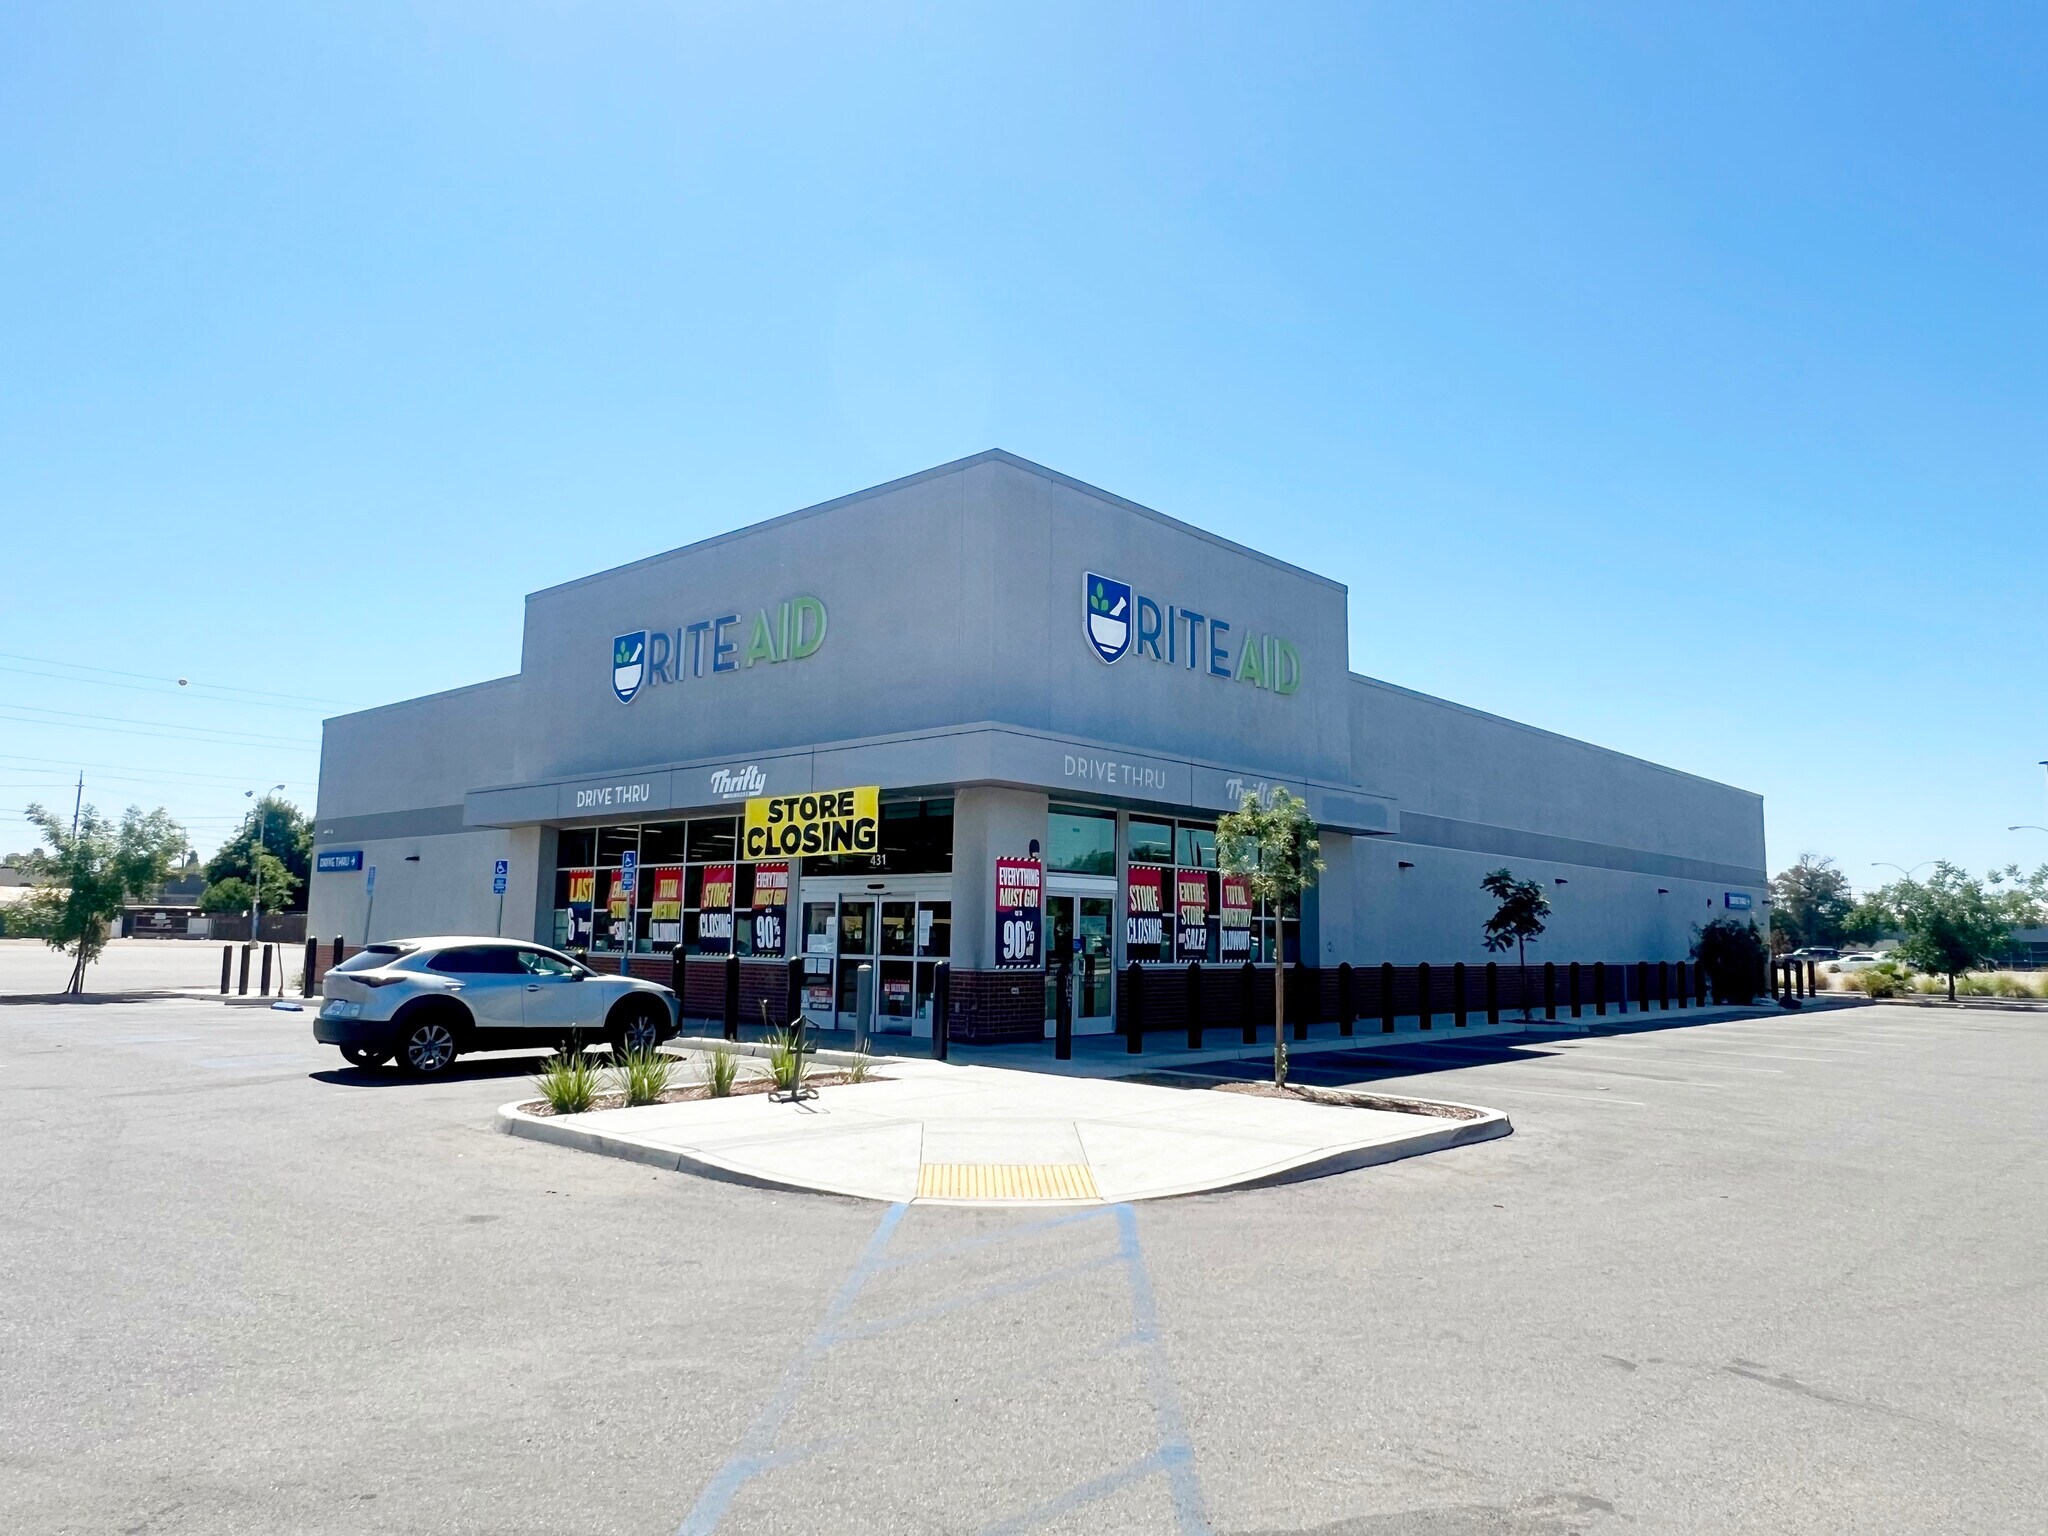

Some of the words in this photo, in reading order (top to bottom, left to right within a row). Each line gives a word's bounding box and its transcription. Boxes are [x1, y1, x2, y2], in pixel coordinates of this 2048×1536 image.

[649, 614, 741, 686] RITE
[745, 596, 828, 668] AID
[1132, 595, 1232, 679] RITE
[1234, 629, 1301, 695] AID
[711, 765, 766, 798] Thrifty
[1064, 755, 1117, 783] DRIVE
[1121, 764, 1165, 790] THRU
[577, 787, 612, 808] DRIVE
[615, 784, 650, 804] THRU
[768, 791, 854, 824] STORE
[747, 818, 877, 857] CLOSING
[870, 854, 886, 866] 431
[999, 867, 1040, 887] EVERYTHING
[569, 878, 594, 903] LAST
[704, 882, 732, 907] STORE
[1000, 888, 1024, 907] MUST
[1024, 889, 1038, 907] GO!
[1129, 885, 1160, 912] STORE
[1178, 882, 1206, 903] ENTIRE
[1225, 885, 1247, 905] TOTAL
[699, 913, 731, 938] CLOSING
[1181, 905, 1206, 925] STORE
[1003, 920, 1035, 959] 90%
[1127, 918, 1162, 944] CLOSING
[1184, 928, 1207, 950] SALE!
